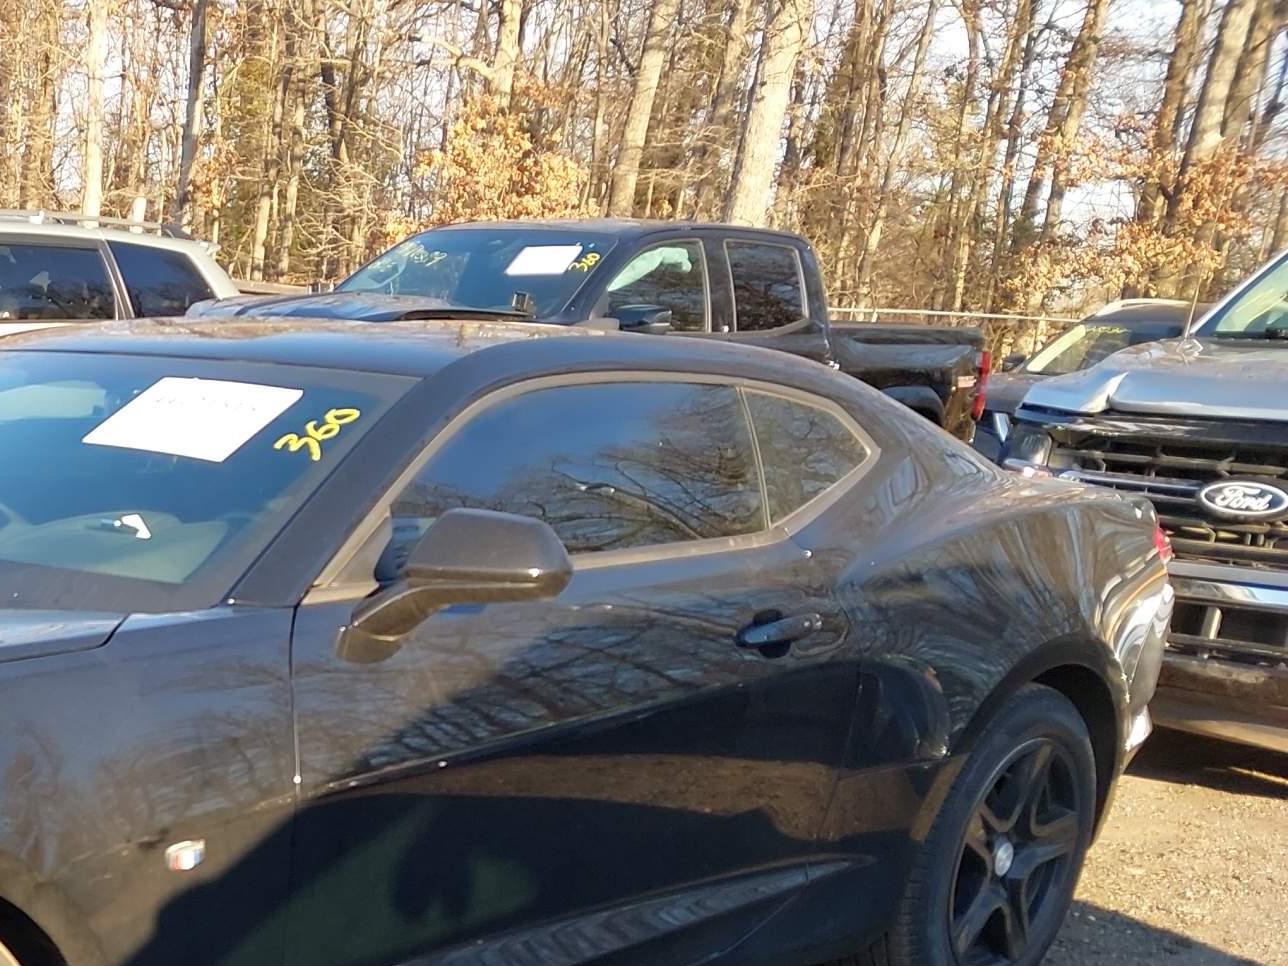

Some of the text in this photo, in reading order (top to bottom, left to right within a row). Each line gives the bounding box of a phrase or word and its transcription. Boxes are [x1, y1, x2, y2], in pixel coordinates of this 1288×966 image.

[568, 252, 601, 274] 360
[273, 408, 361, 461] 360
[1215, 485, 1273, 511] Ford
